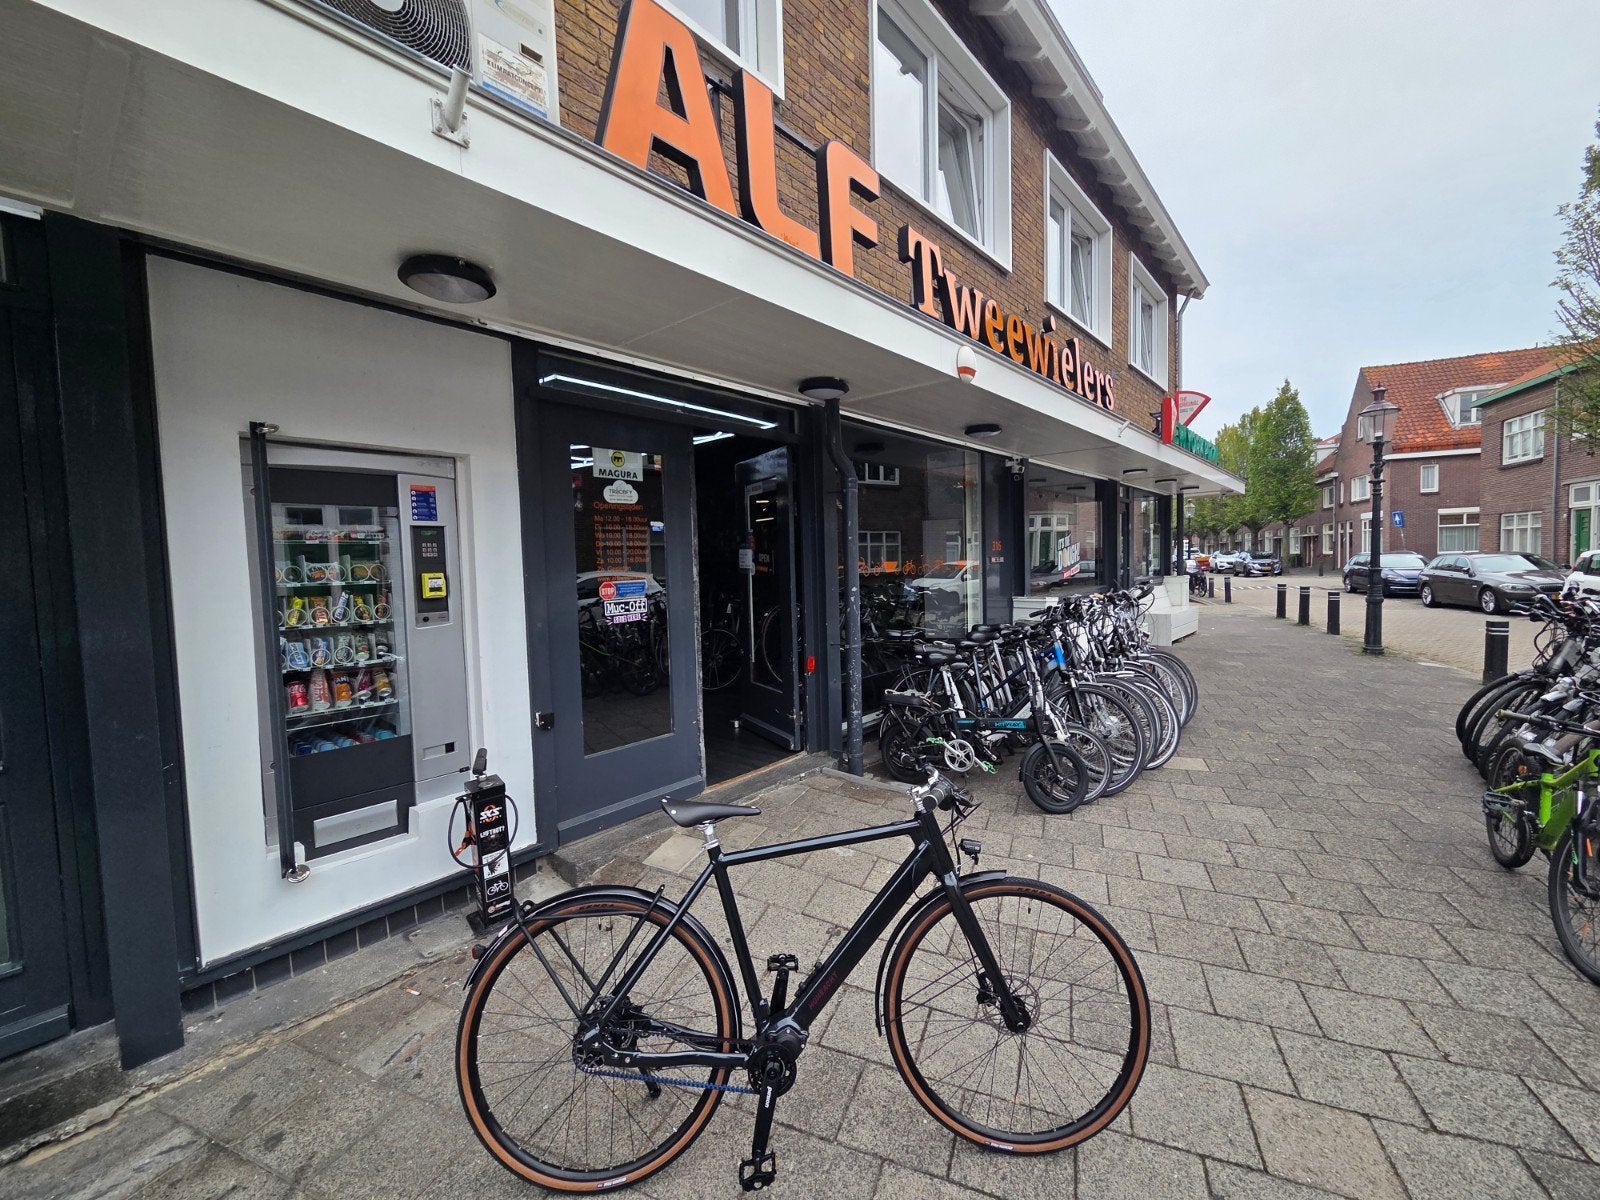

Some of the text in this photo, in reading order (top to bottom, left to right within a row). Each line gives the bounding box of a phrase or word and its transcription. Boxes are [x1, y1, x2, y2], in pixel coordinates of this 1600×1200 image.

[596, 0, 1113, 411] ALF Tweewielers
[598, 468, 638, 480] MAGURA
[602, 587, 615, 596] STOP
[606, 600, 645, 614] Muc-Off
[480, 807, 502, 820] SKS
